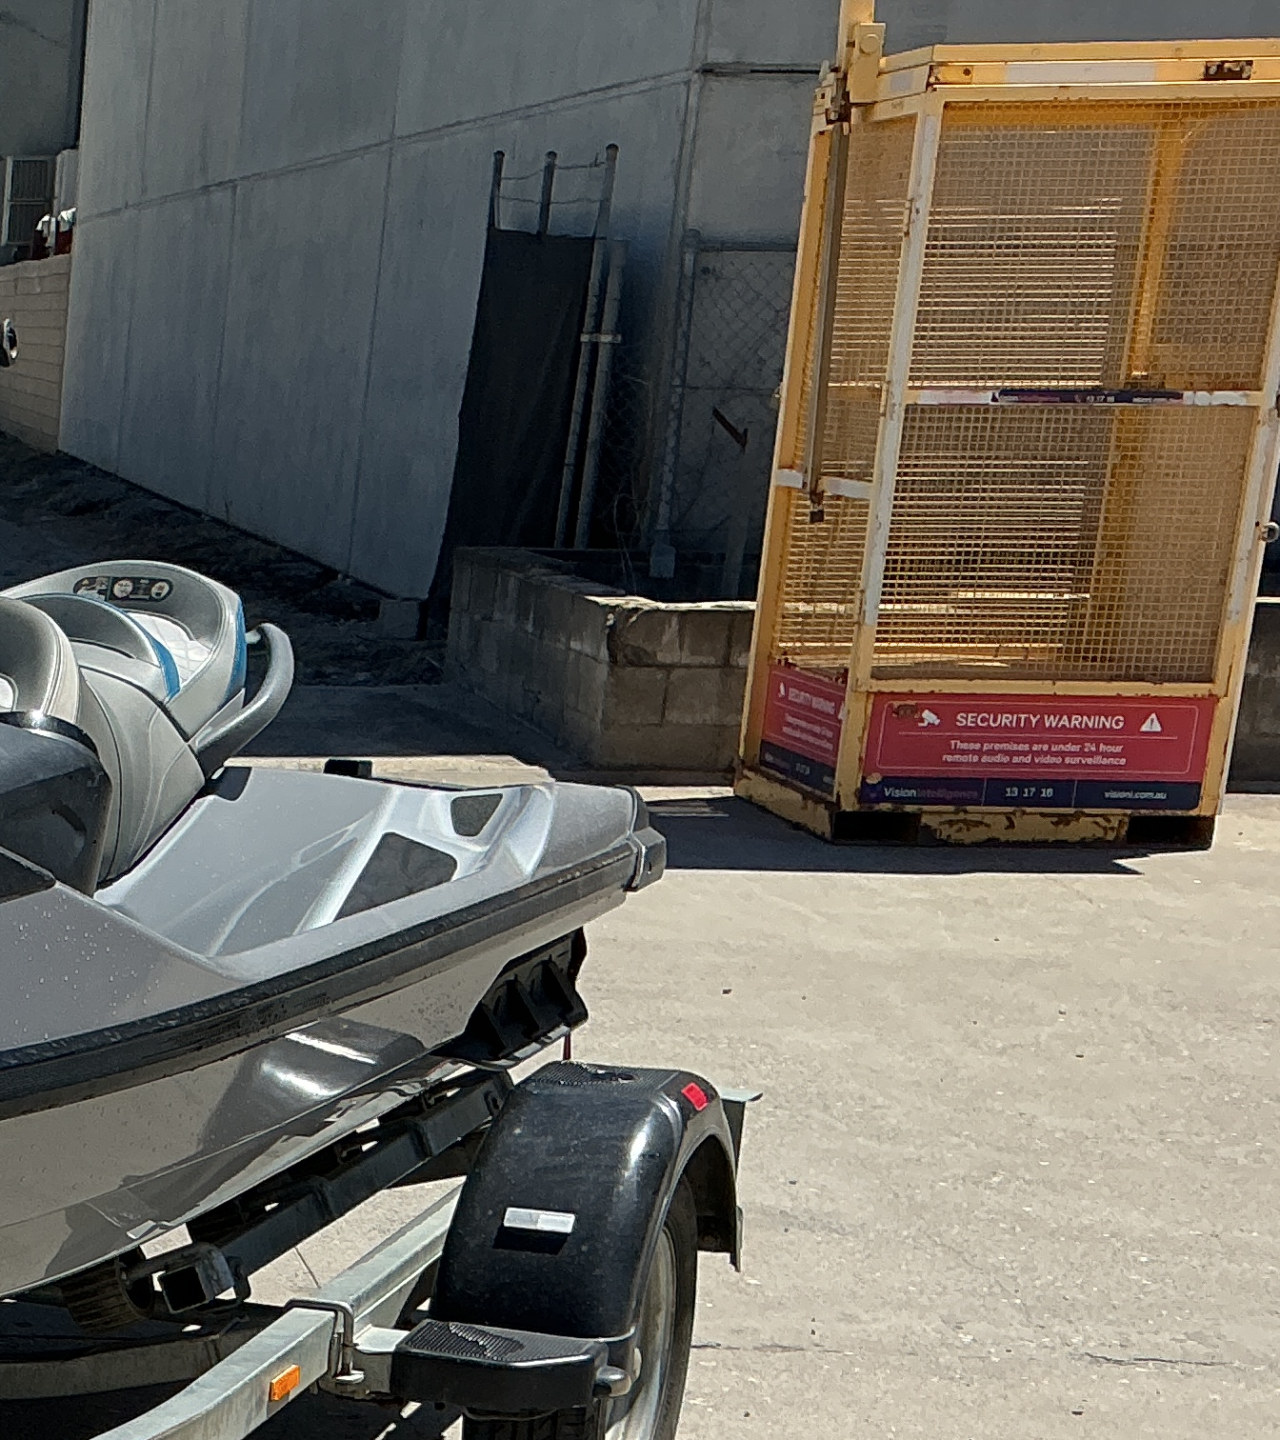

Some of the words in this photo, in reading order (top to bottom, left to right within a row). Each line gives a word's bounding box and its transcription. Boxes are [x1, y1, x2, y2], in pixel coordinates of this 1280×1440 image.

[955, 713, 1040, 728] SECURITY
[1044, 714, 1125, 730] WARNING
[950, 740, 981, 750] These
[983, 741, 1030, 753] premises
[1032, 743, 1049, 752] are
[1051, 742, 1082, 752] under
[1099, 743, 1123, 753] hour
[1012, 754, 1032, 764] and
[1034, 754, 1062, 765] video
[1064, 755, 1127, 766] surveillance
[1005, 787, 1018, 797] 13
[1022, 787, 1035, 797] 17
